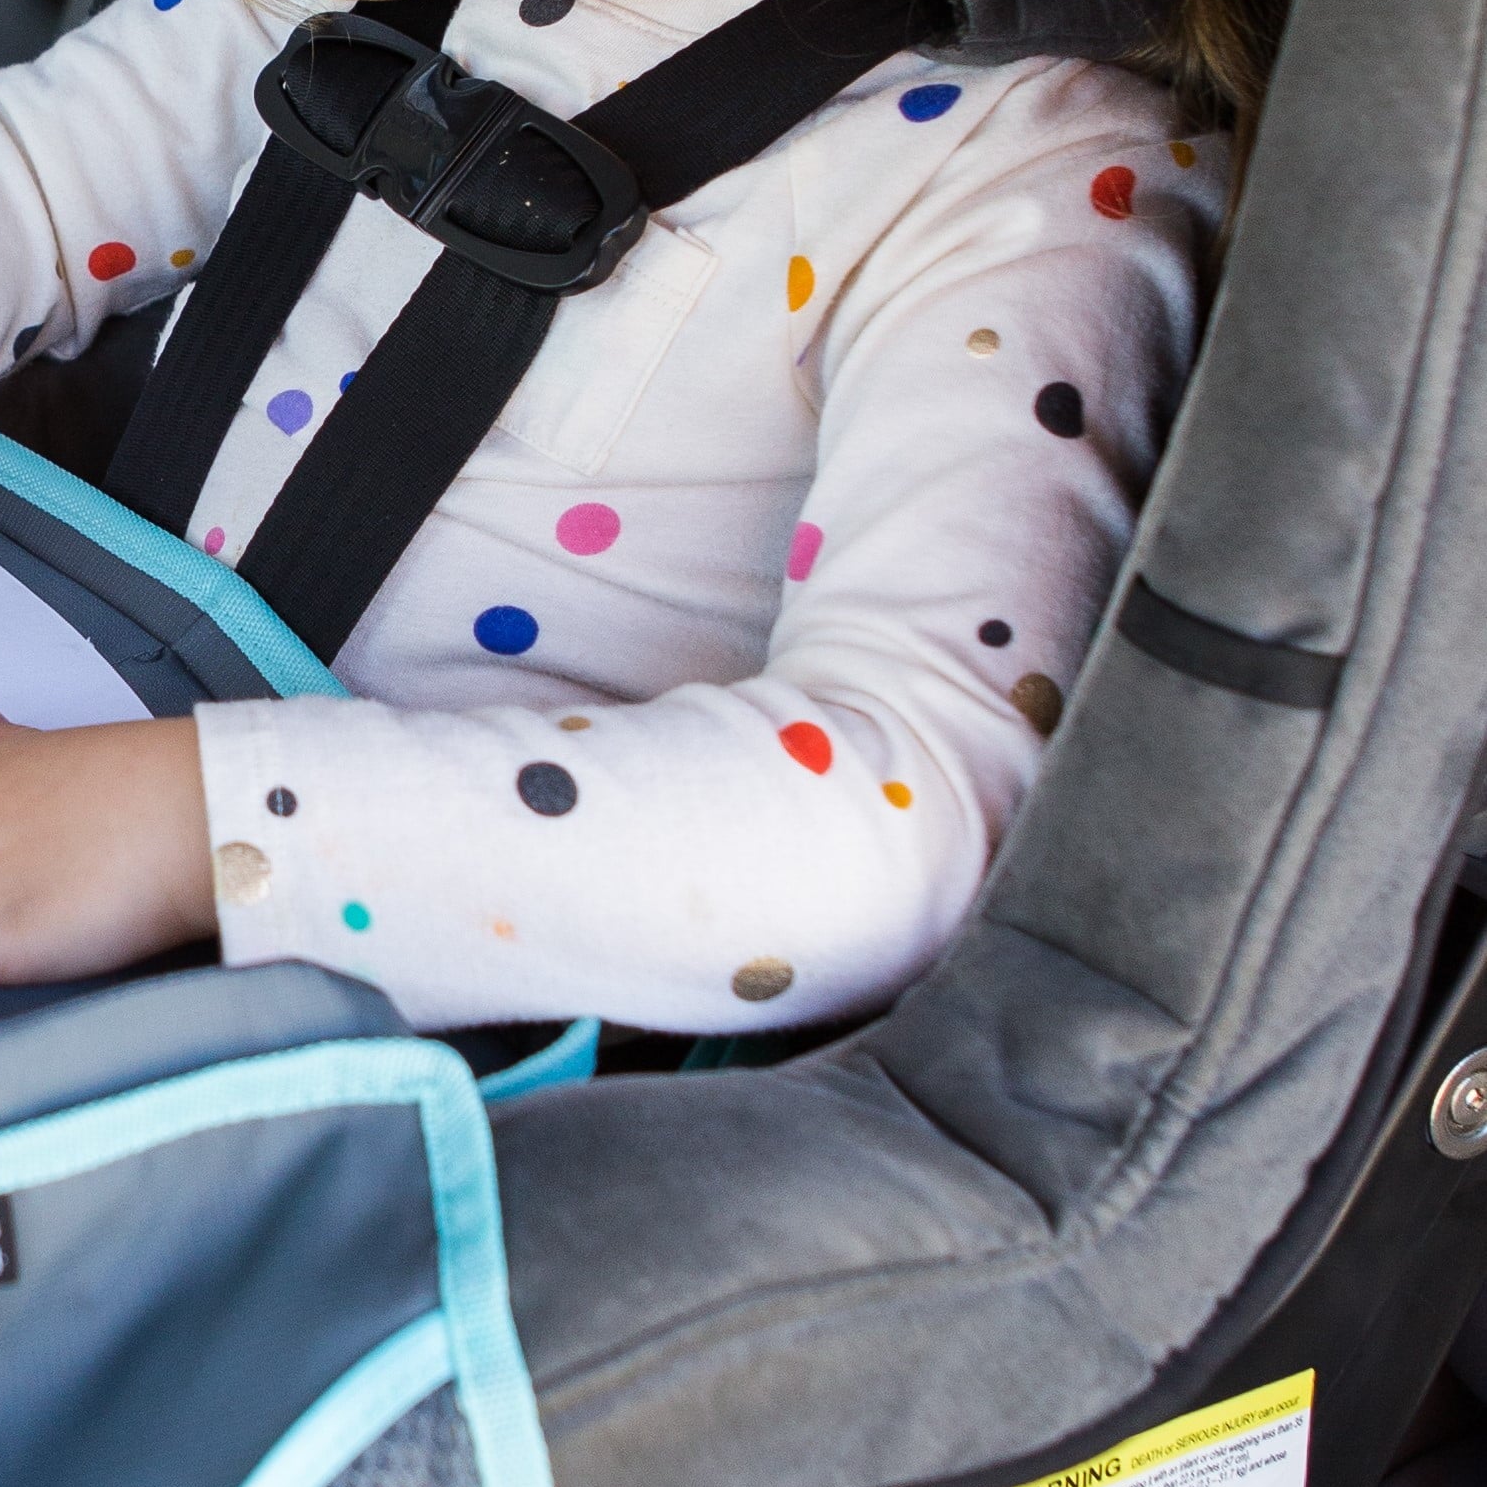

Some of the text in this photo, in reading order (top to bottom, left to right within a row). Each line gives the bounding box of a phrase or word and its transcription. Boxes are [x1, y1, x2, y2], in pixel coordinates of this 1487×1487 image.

[1131, 1445, 1163, 1469] DEATH
[1164, 1443, 1174, 1456] or
[1175, 1422, 1220, 1452] SERIOUS
[1221, 1409, 1255, 1435] INJURY
[1258, 1405, 1274, 1421] can
[1275, 1395, 1299, 1414] occur
